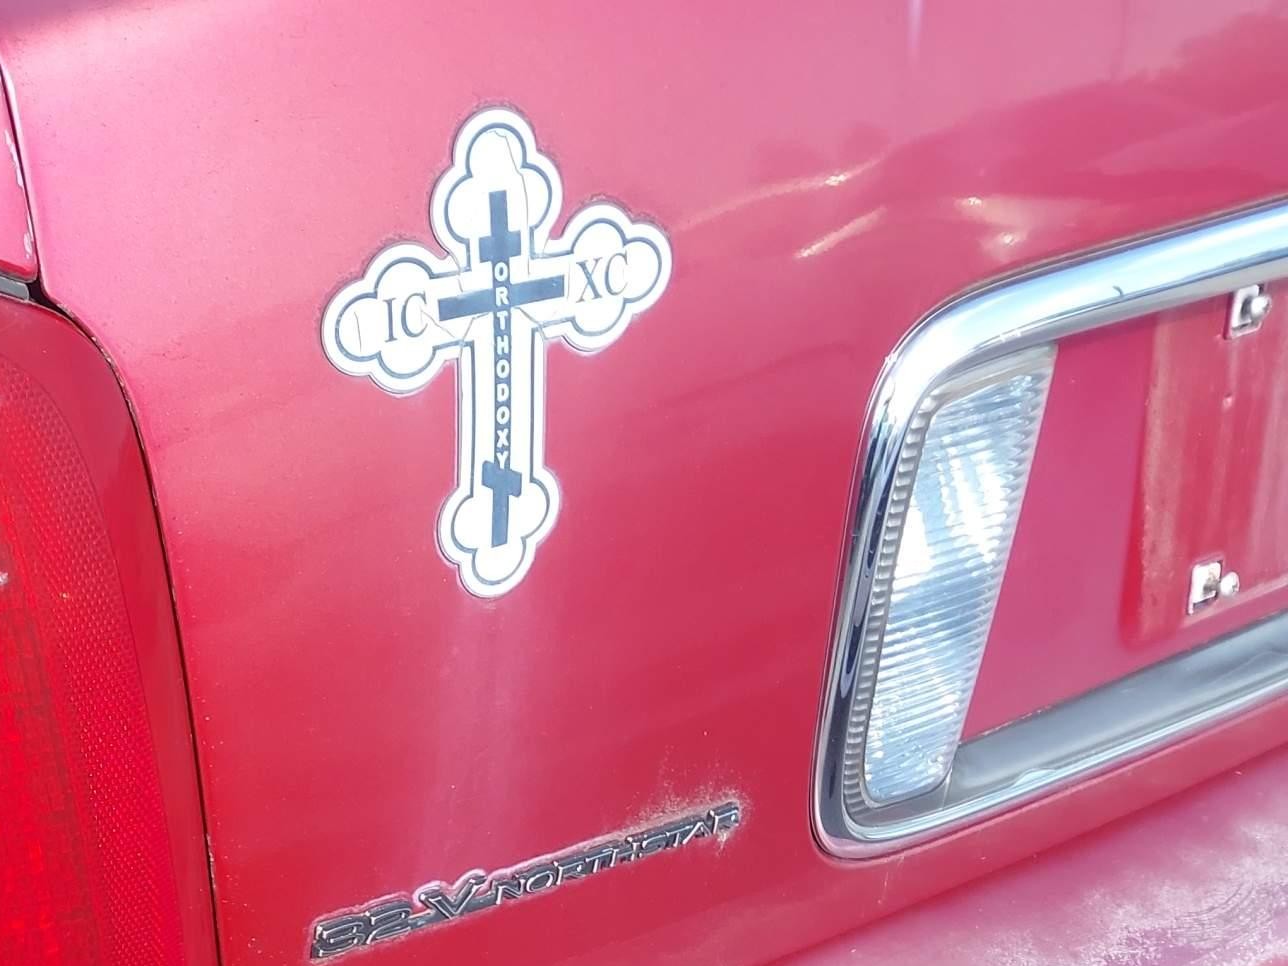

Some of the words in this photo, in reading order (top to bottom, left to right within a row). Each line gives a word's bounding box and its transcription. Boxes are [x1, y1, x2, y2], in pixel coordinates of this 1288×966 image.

[383, 290, 429, 343] IC
[575, 251, 629, 304] XC
[493, 261, 512, 469] ORTHODOXY
[492, 801, 740, 905] NORTHSTAR
